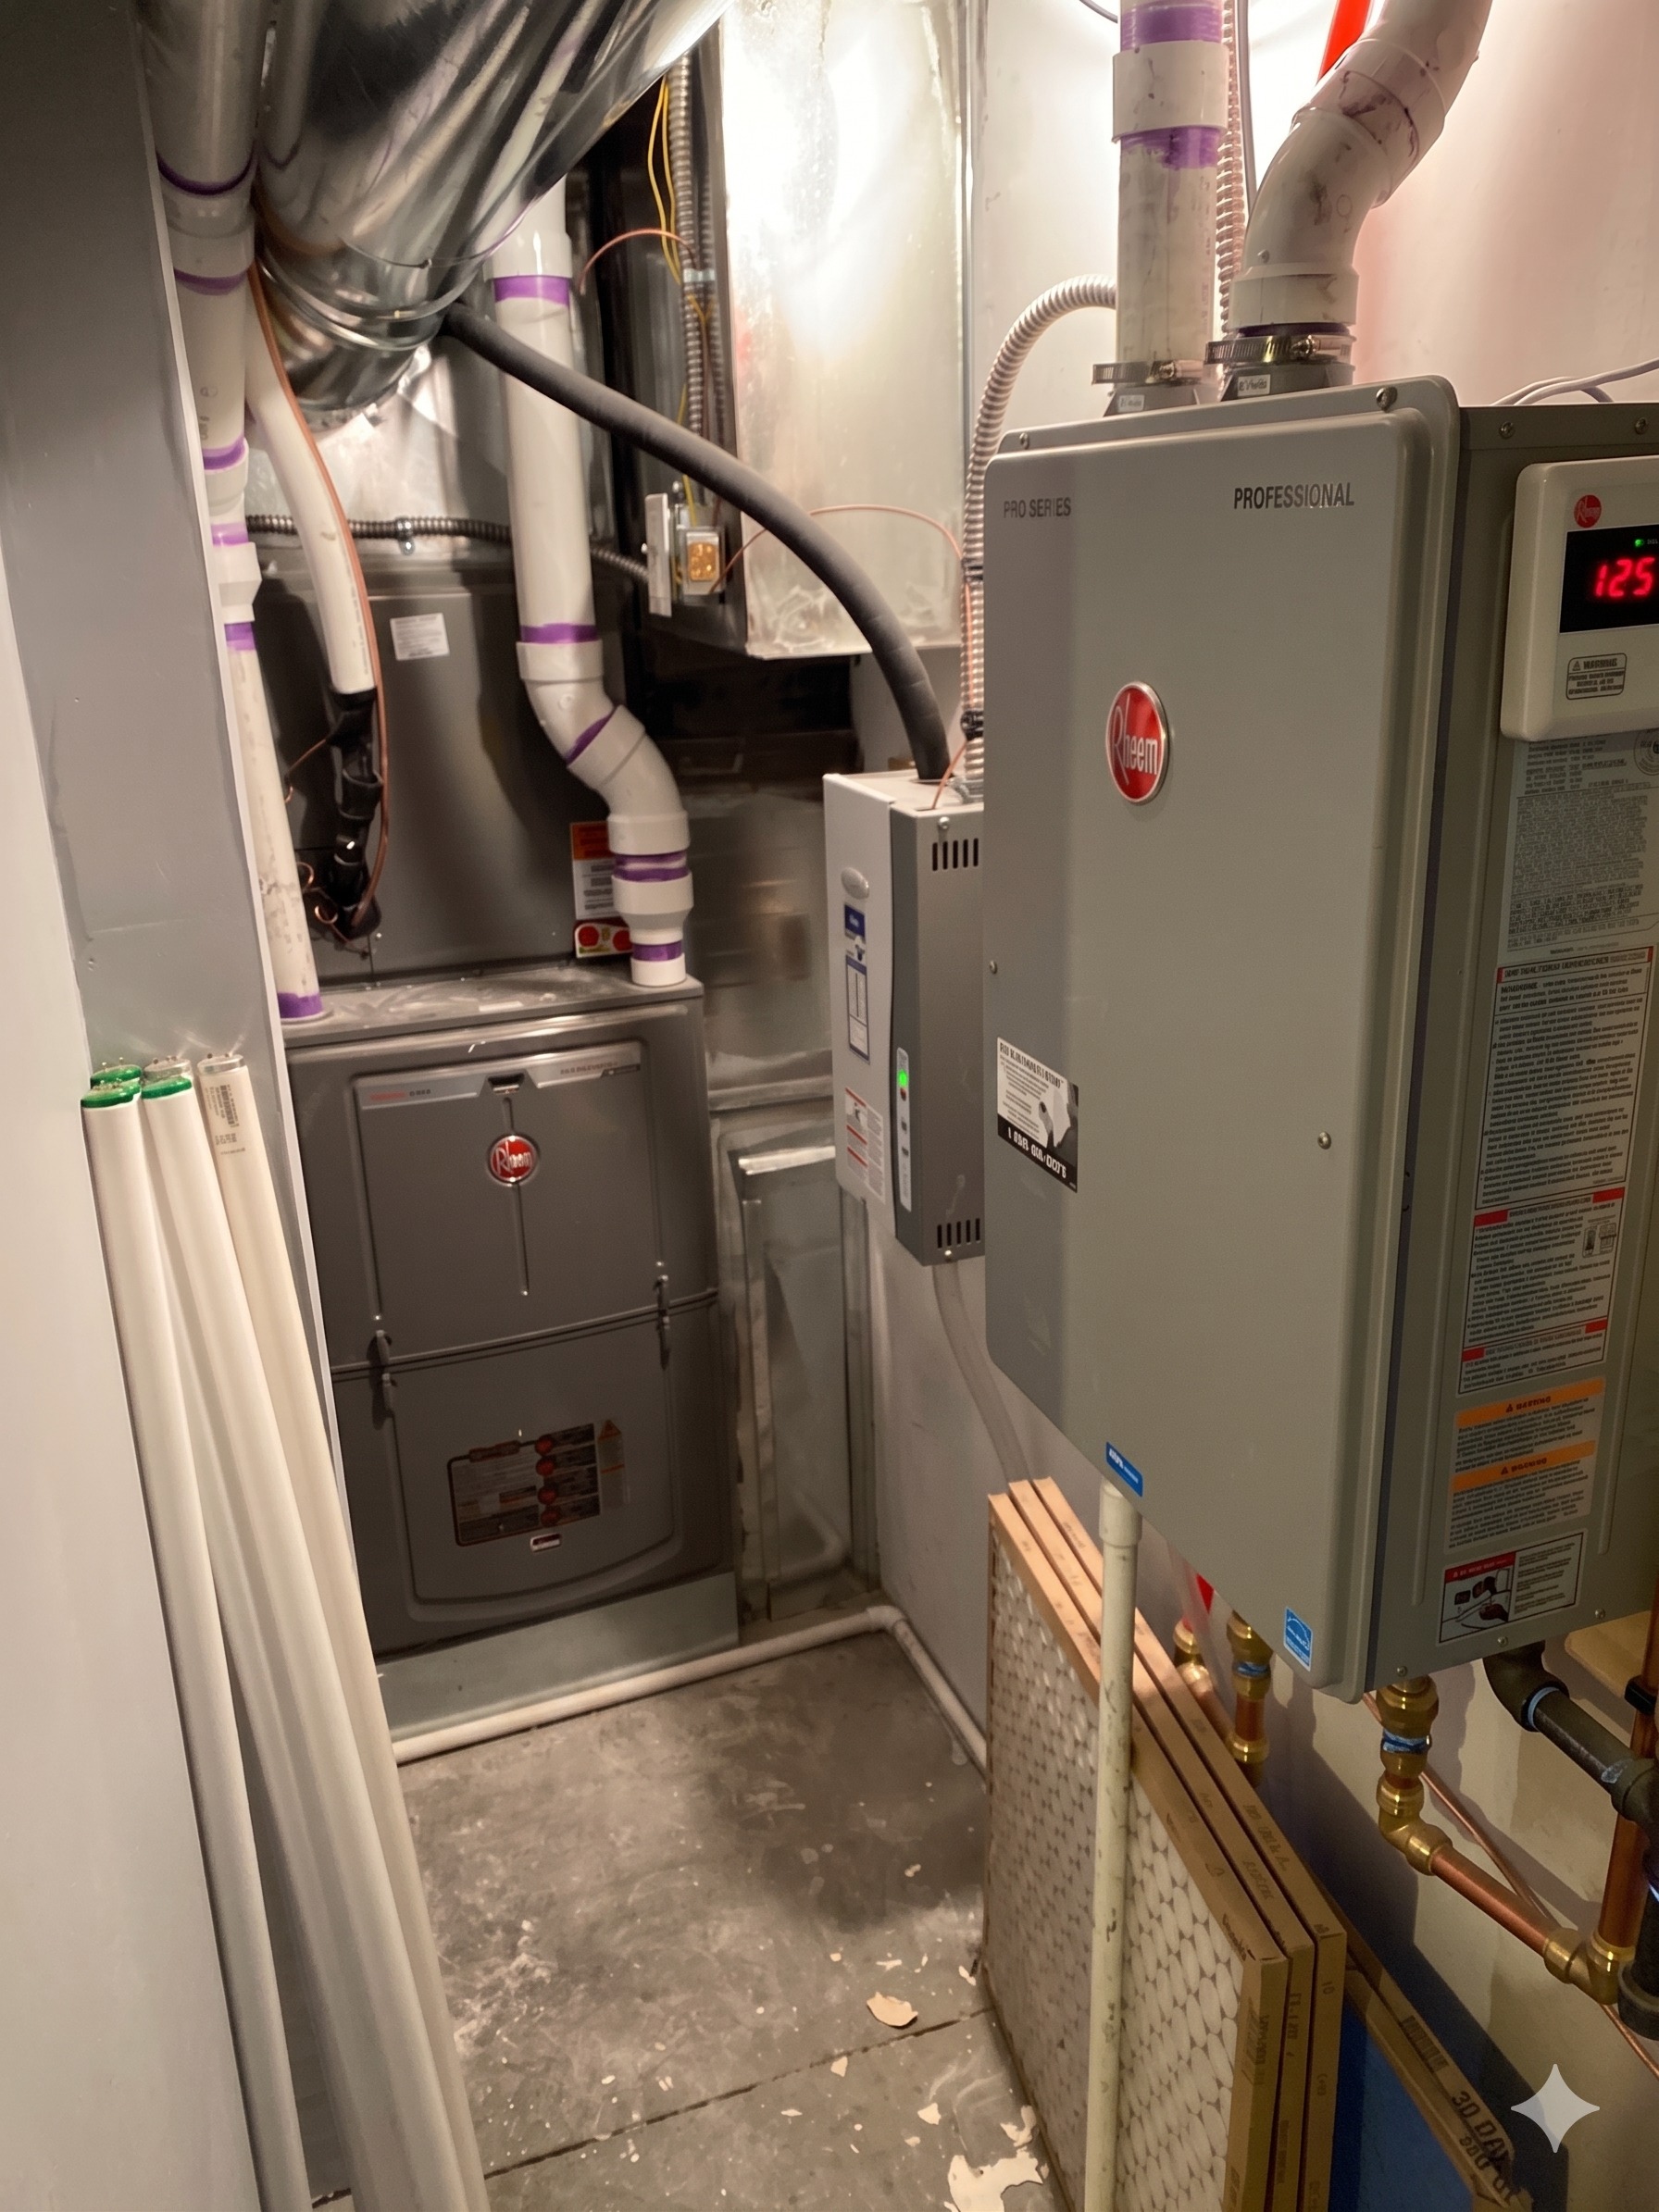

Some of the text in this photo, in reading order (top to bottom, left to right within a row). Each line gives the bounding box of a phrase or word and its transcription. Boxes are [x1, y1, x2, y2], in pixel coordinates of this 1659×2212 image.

[1004, 497, 1072, 518] PRO SERIES
[1233, 482, 1355, 510] PROFESSIONAL
[1593, 556, 1656, 598] 125
[1111, 692, 1158, 786] Rheem
